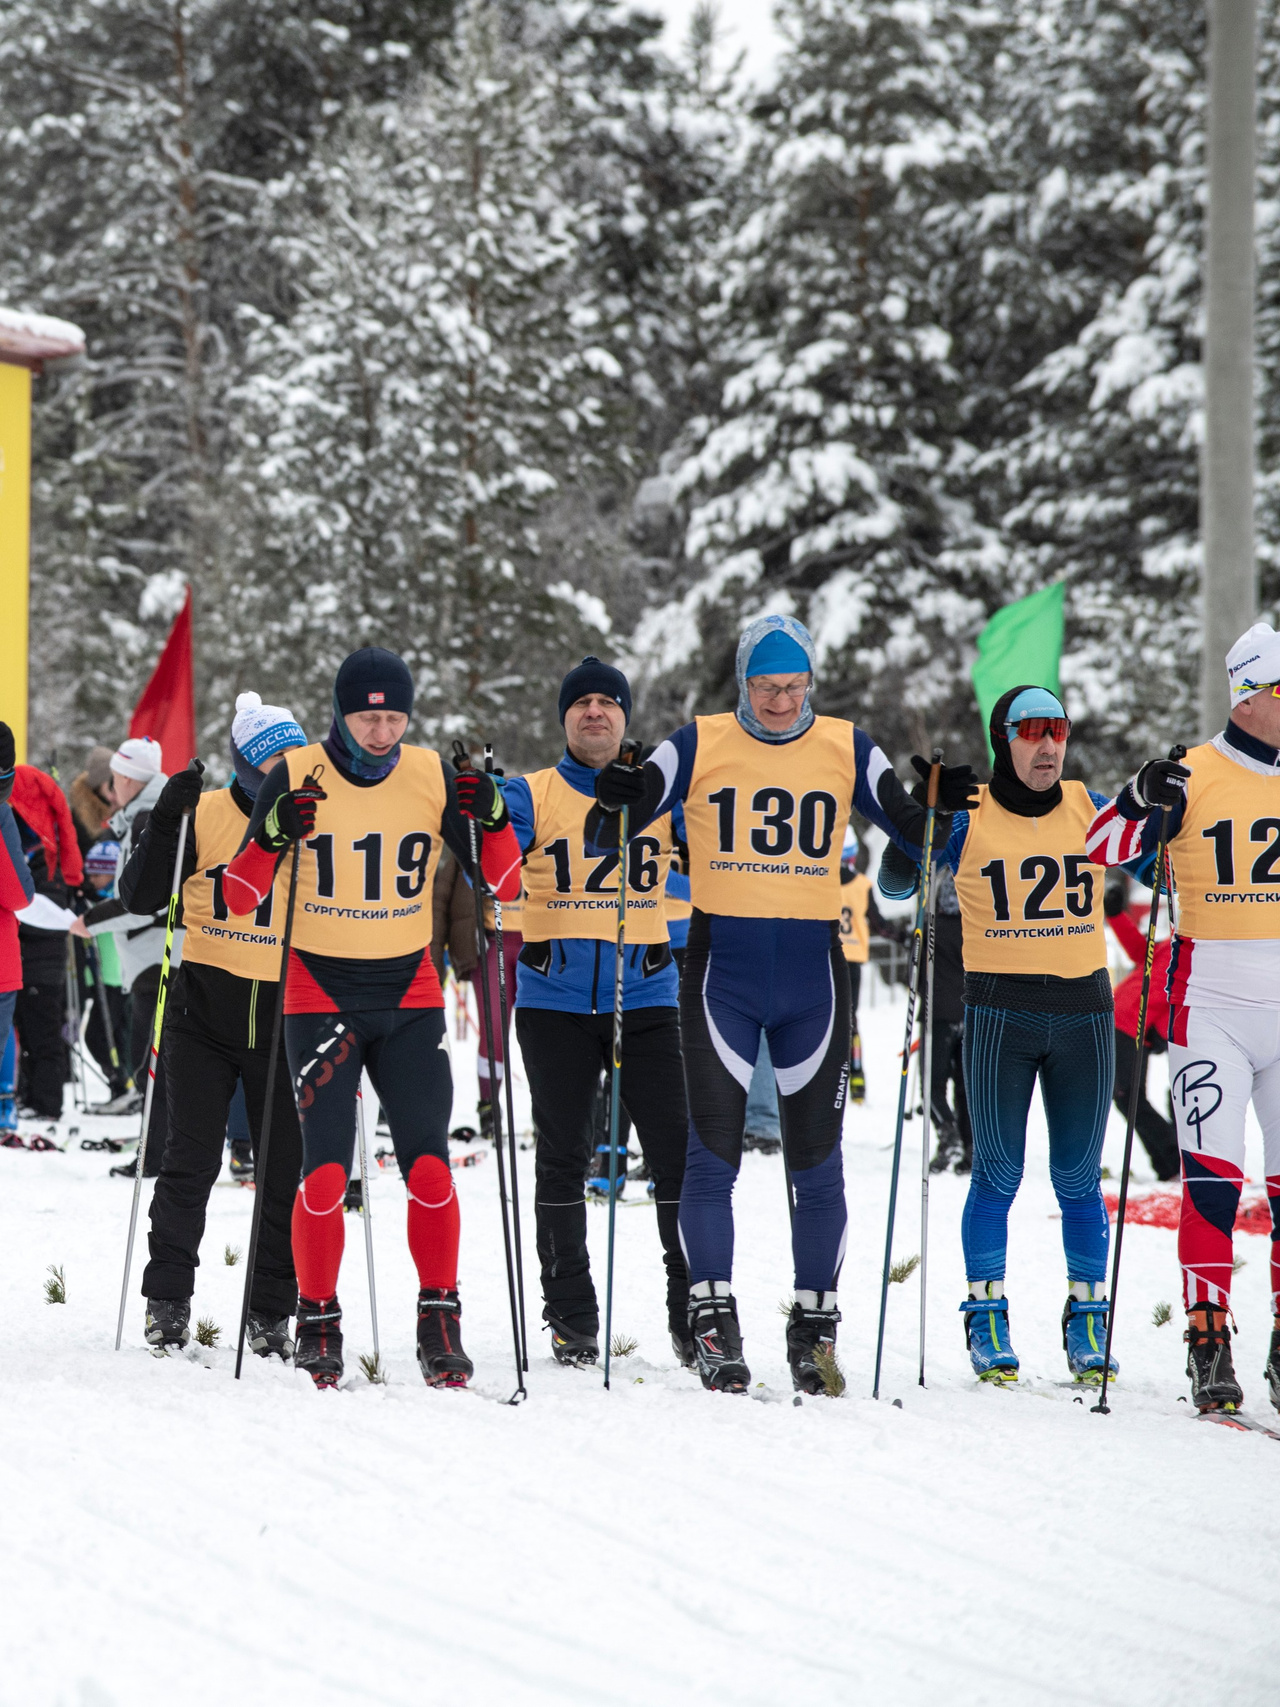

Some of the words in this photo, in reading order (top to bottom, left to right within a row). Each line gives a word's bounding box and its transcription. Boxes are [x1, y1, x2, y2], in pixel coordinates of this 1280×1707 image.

[250, 727, 302, 758] РОССИИ
[707, 786, 838, 859] 130
[306, 832, 433, 902] 119
[544, 835, 661, 894] 126
[710, 860, 790, 875] СУРГУТСКИЙ
[794, 865, 830, 876] РАЙОН
[546, 897, 621, 910] СУРГУТСКИЙ
[627, 899, 658, 910] РАЙОН
[980, 854, 1094, 922] 125
[304, 902, 389, 920] СУРГУТСКИЙ
[392, 901, 423, 920] РАЙОН
[201, 925, 277, 946] СУРГУТСКИЙ
[984, 924, 1064, 939] СУРГУТСКИЙ
[1067, 922, 1096, 936] РАЙОН
[1145, 924, 1156, 978] SWIX
[834, 1071, 848, 1109] CRAFT
